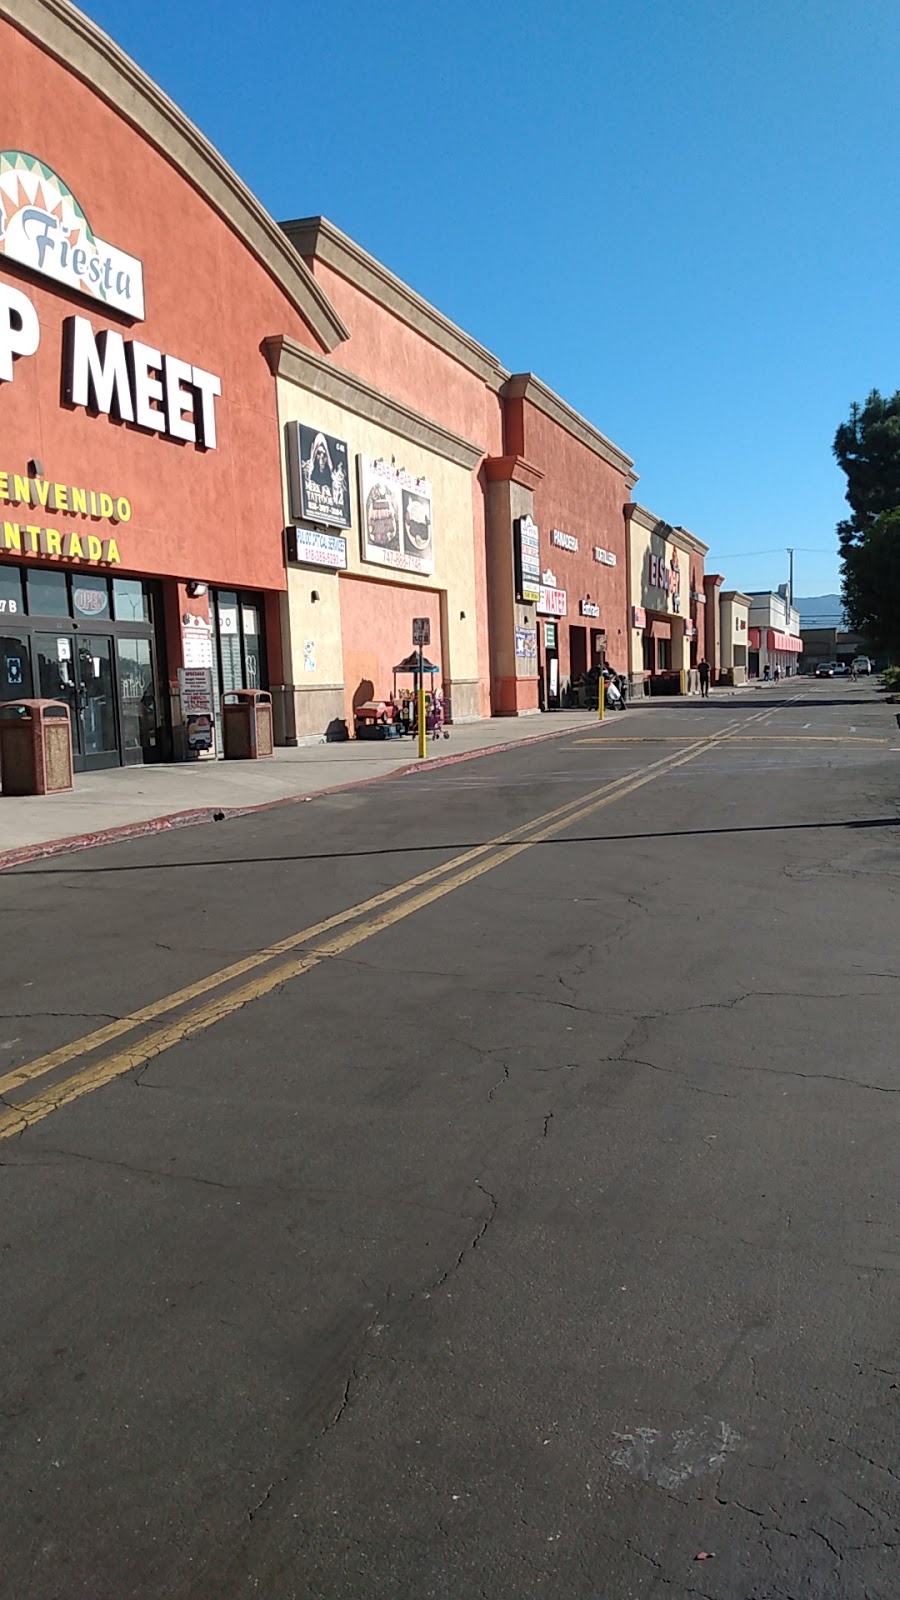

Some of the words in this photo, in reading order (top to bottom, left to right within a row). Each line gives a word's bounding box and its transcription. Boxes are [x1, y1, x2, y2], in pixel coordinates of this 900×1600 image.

[22, 209, 131, 300] Fiesta
[70, 315, 221, 450] MEET
[3, 521, 121, 563] NTRADA
[8, 598, 17, 612] B
[77, 591, 103, 610] OPEN
[544, 588, 565, 614] WATER
